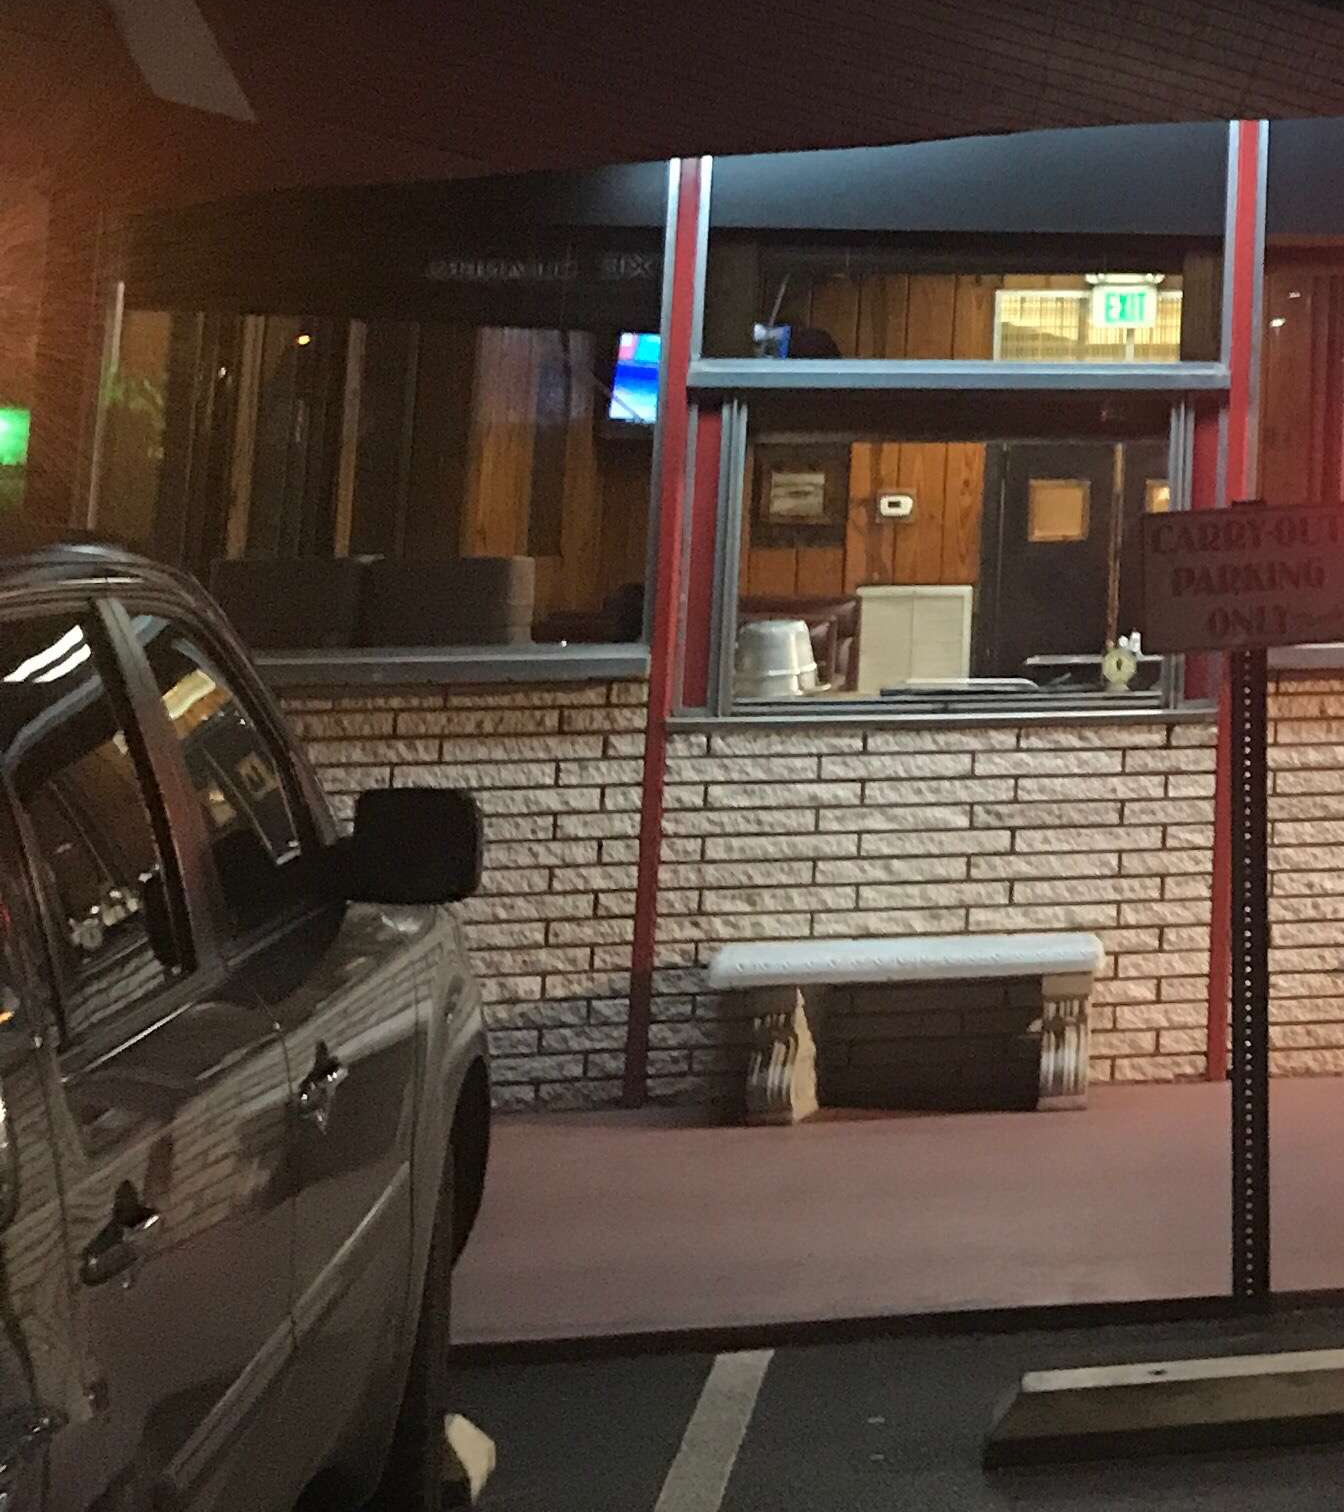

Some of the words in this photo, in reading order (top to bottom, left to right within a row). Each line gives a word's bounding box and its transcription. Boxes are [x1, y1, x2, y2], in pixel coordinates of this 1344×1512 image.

[1104, 292, 1146, 323] EXIT
[1150, 514, 1341, 555] CARRY-OUT
[1170, 557, 1326, 598] PARKING
[1206, 604, 1290, 637] ONLY
